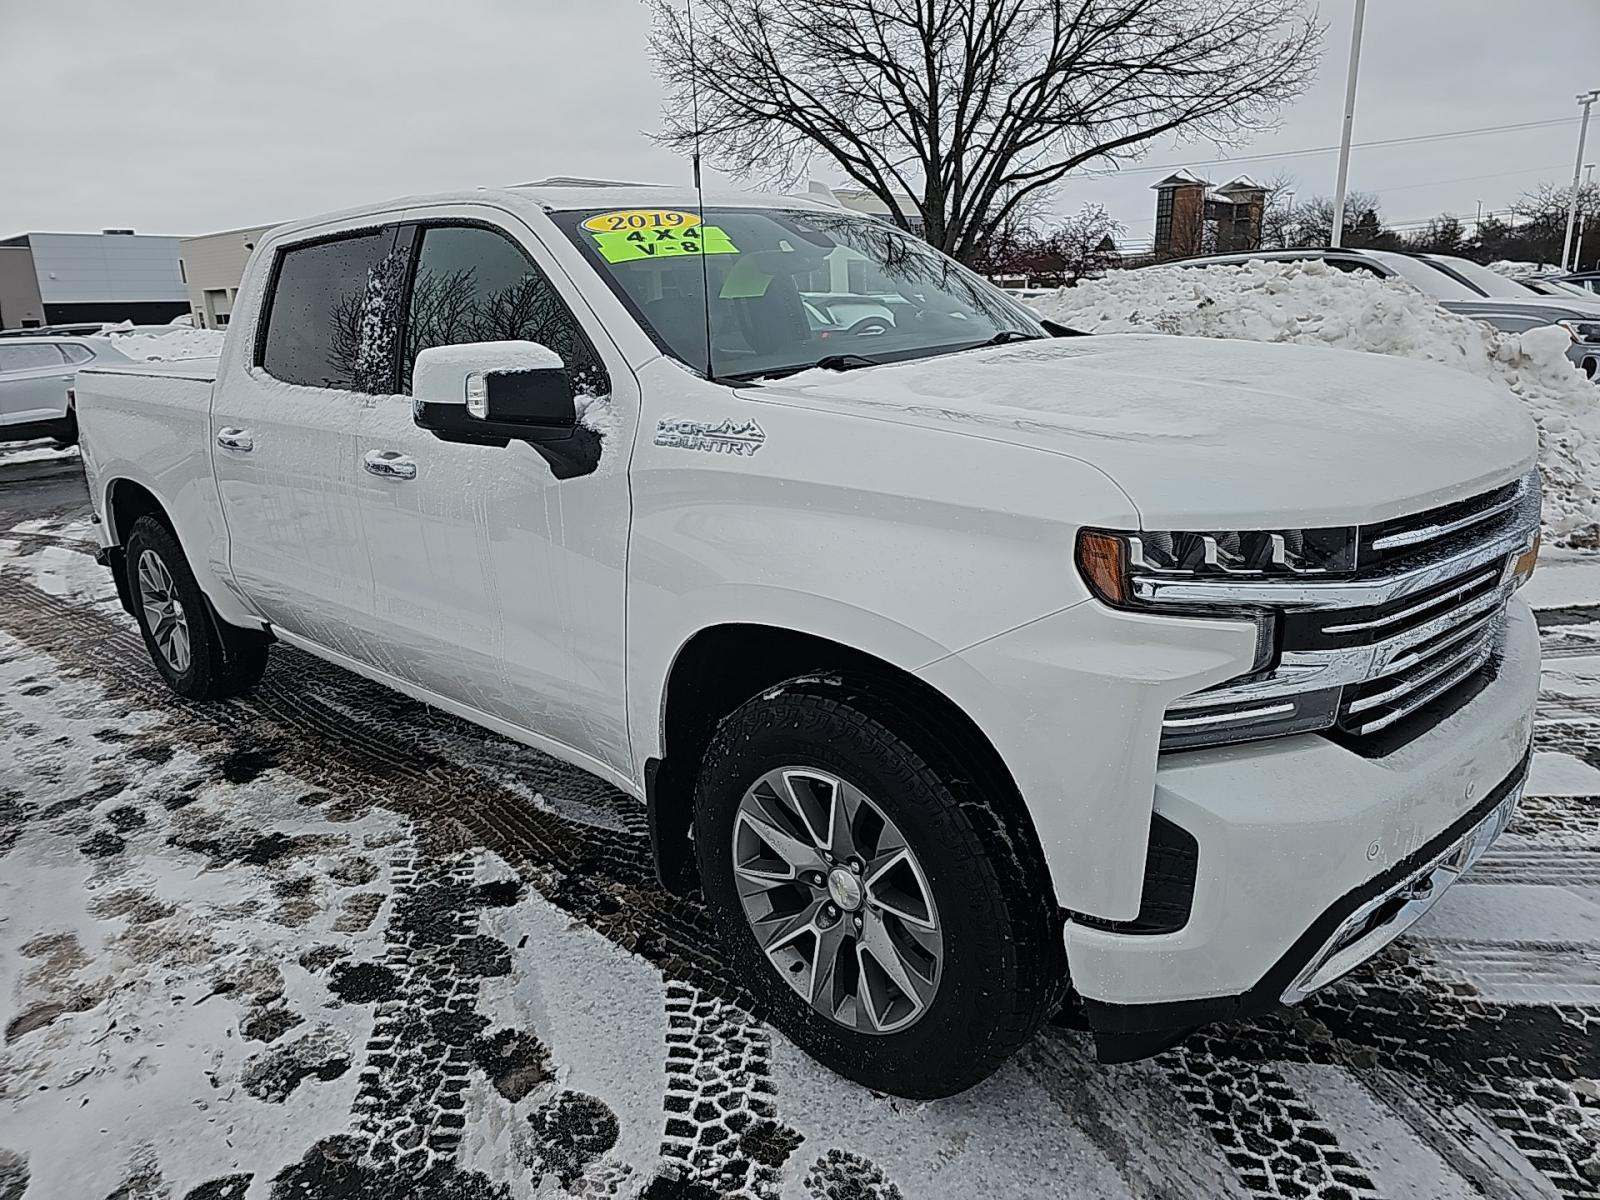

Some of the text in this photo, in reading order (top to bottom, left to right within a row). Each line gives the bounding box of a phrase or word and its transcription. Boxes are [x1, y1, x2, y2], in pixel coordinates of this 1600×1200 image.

[606, 213, 685, 231] 2019
[626, 227, 701, 243] 4X4
[635, 241, 700, 255] V-8
[653, 433, 762, 457] COUNTRY
